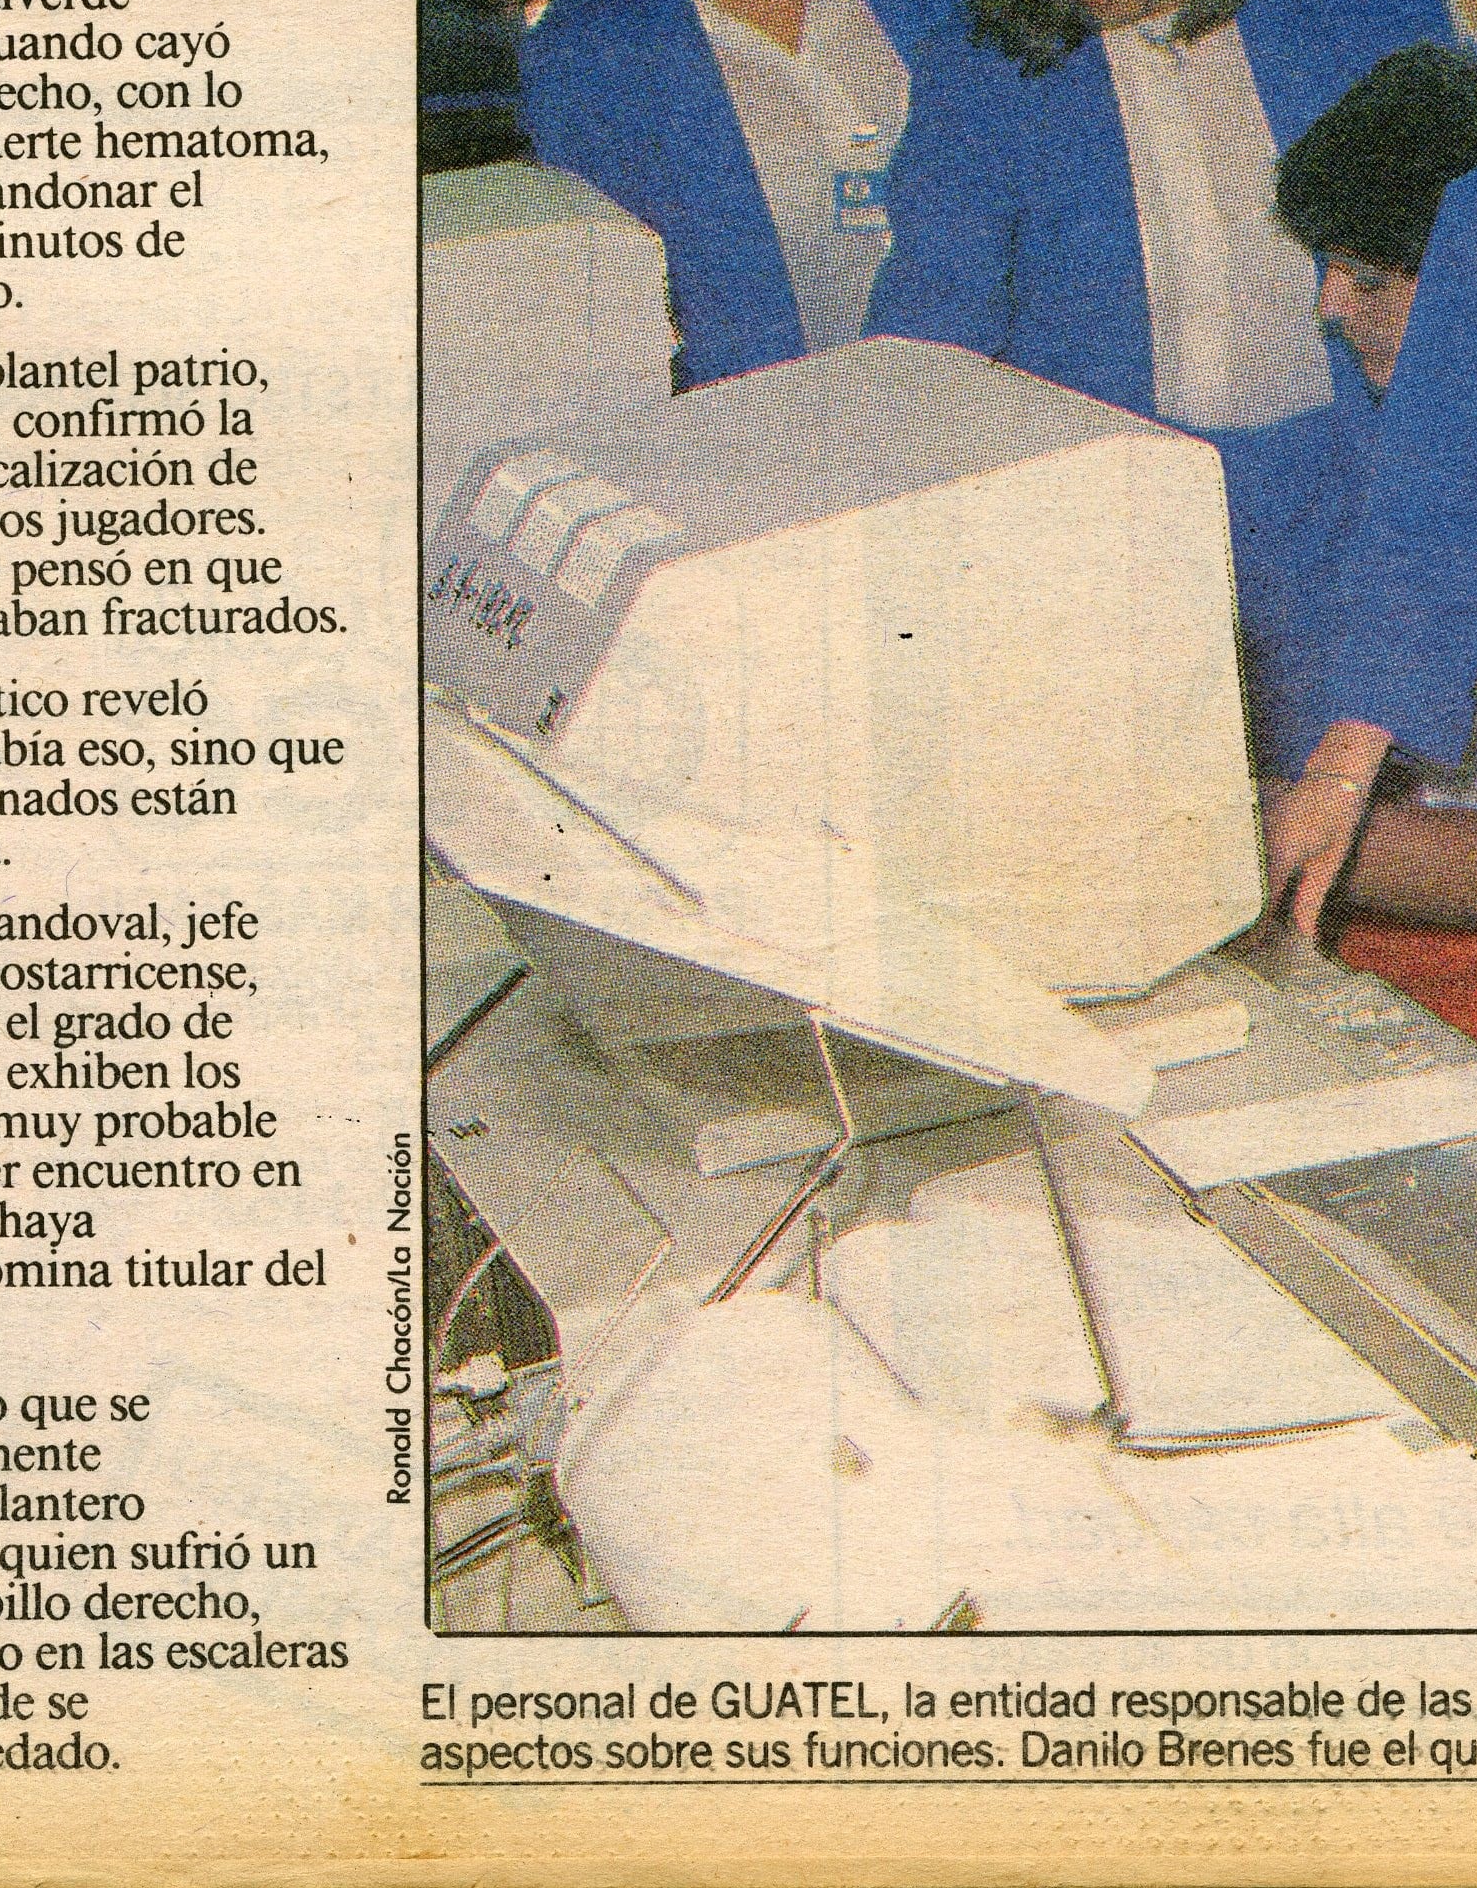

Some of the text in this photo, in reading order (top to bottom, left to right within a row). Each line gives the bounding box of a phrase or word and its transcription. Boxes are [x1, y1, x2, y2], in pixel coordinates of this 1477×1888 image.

[14, 398, 204, 438] confirmó
[219, 398, 254, 435] la
[83, 679, 207, 716] reveló
[181, 904, 258, 949] jefe
[386, 1133, 411, 1503] Ronald Chacón/La Nación
[0, 1532, 117, 1579] quien
[131, 1531, 250, 1570] sufrió
[264, 1543, 317, 1569] un
[421, 1729, 592, 1772] aspectos
[606, 1733, 712, 1769] sobre
[726, 1741, 790, 1768] sus
[804, 1731, 1003, 1767] funciones.
[1023, 1731, 1143, 1767] Danilo
[1159, 1730, 1294, 1766] Brenes
[1308, 1730, 1370, 1766] fue
[1384, 1730, 1414, 1766] el
